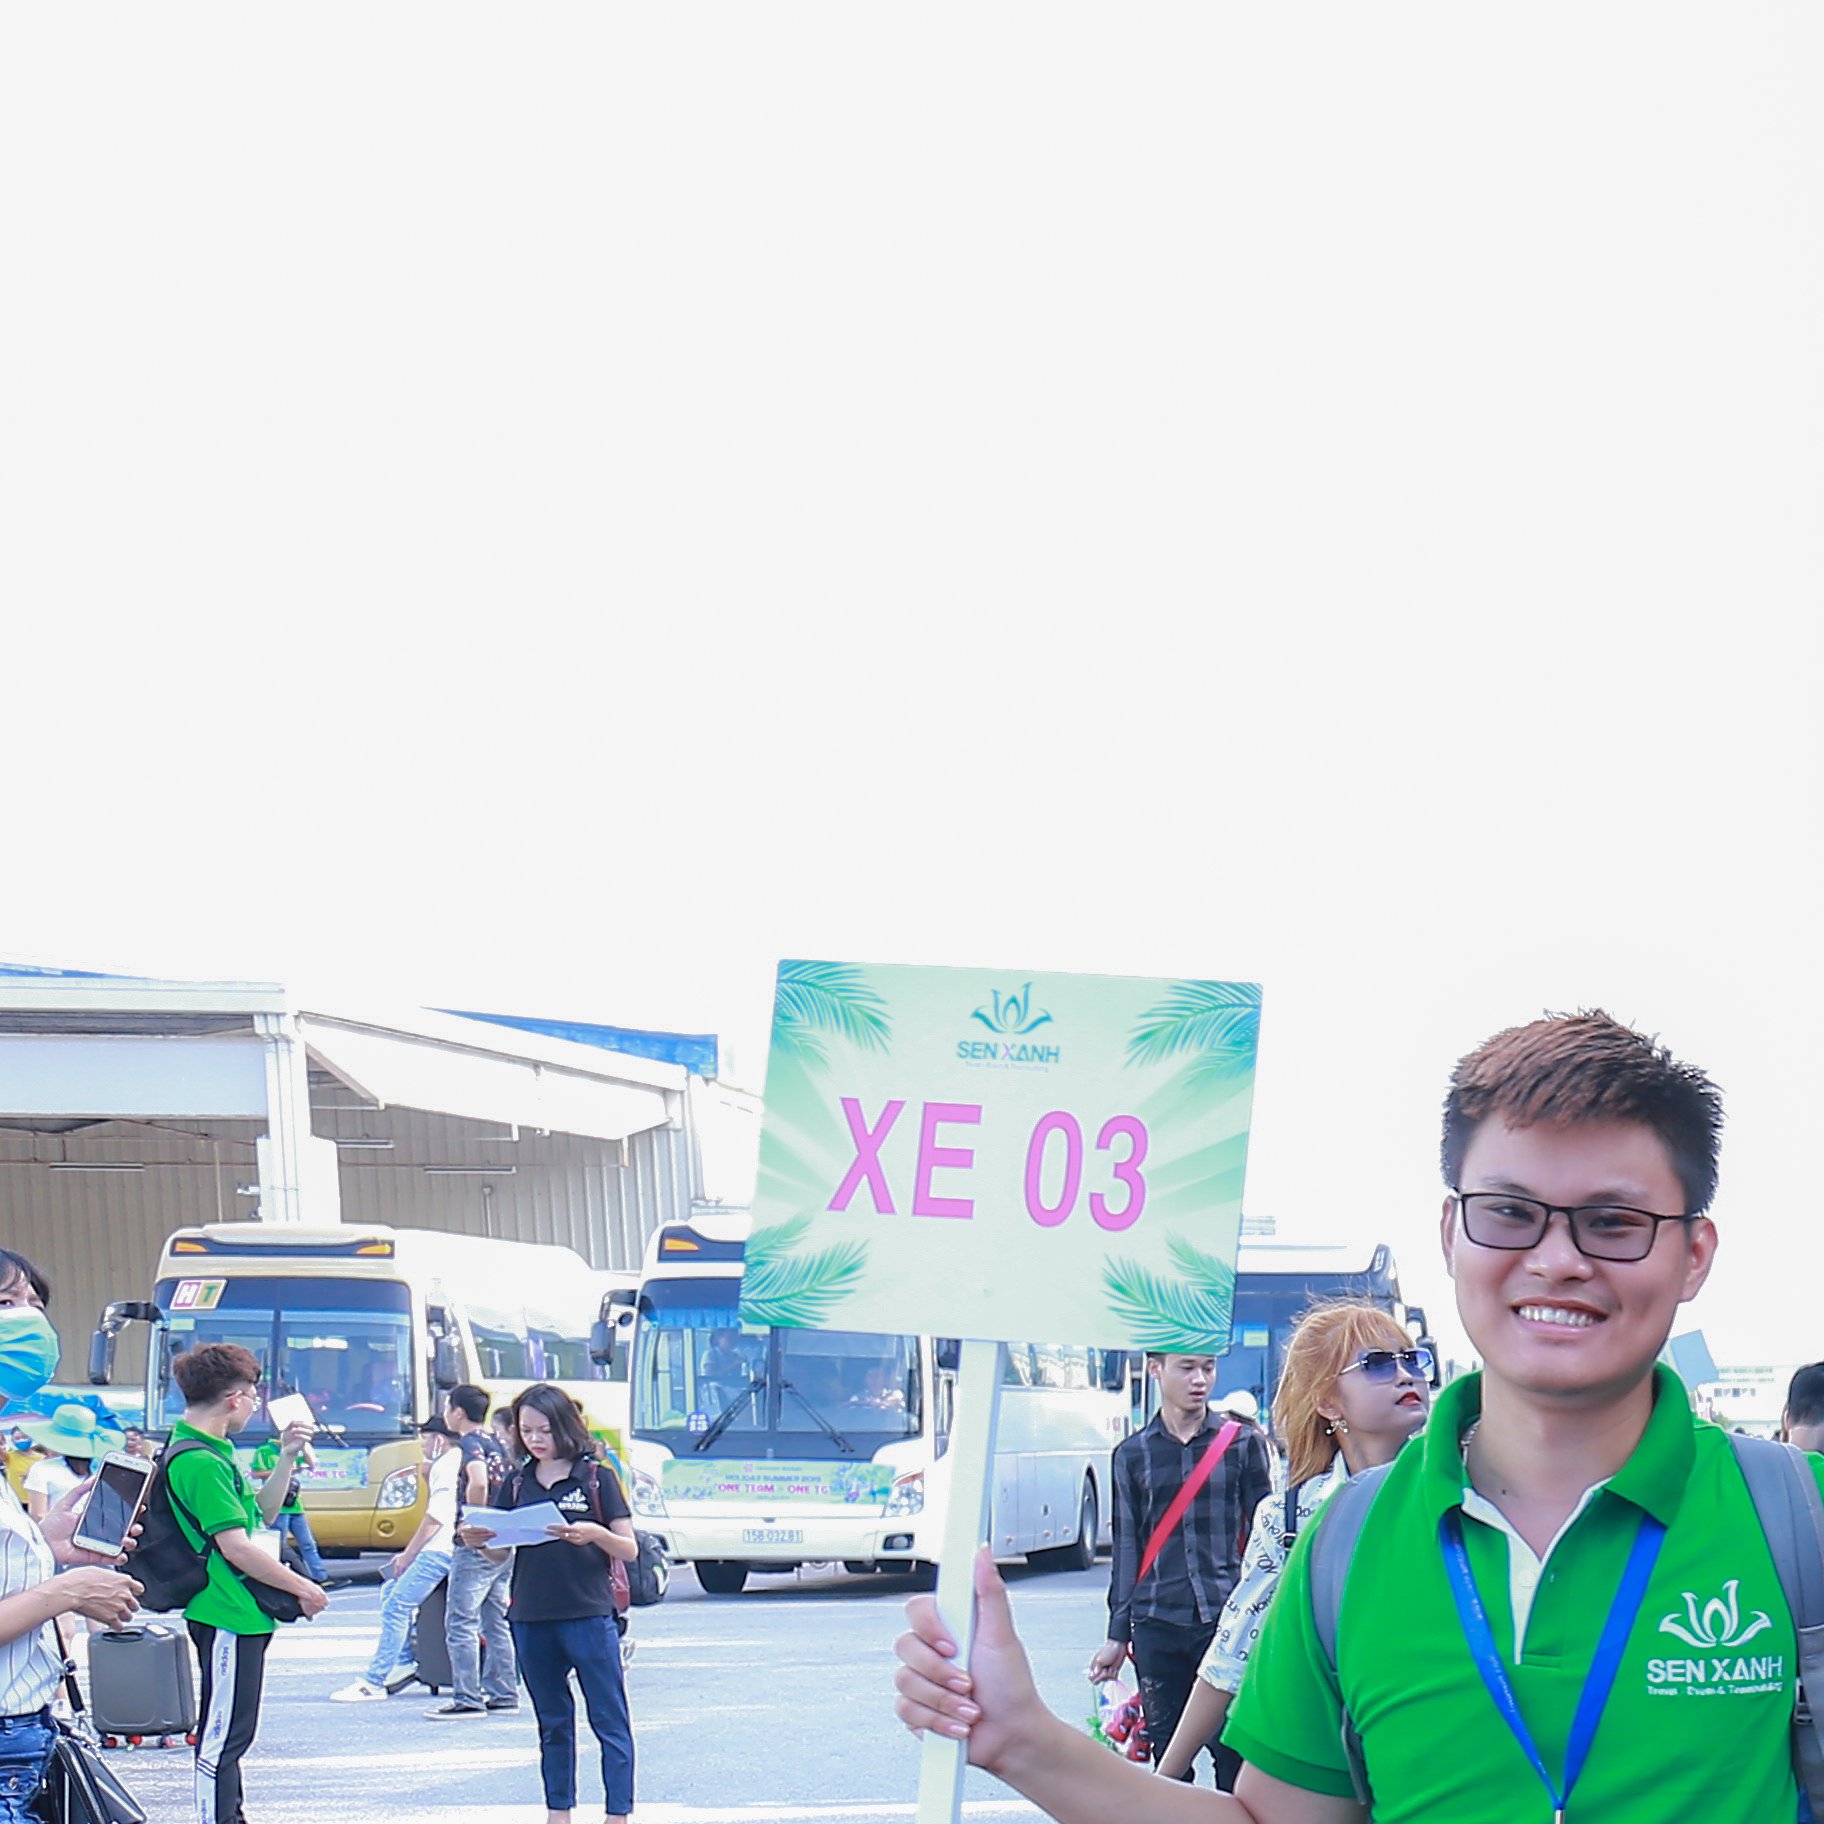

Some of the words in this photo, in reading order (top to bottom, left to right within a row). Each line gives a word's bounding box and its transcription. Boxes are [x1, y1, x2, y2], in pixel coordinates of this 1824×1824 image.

[956, 1039, 999, 1061] SEN
[1000, 1042, 1061, 1065] XANH
[825, 1095, 984, 1221] XE
[1023, 1109, 1150, 1233] 03
[1646, 1657, 1706, 1683] SEN
[1711, 1655, 1784, 1682] XANH
